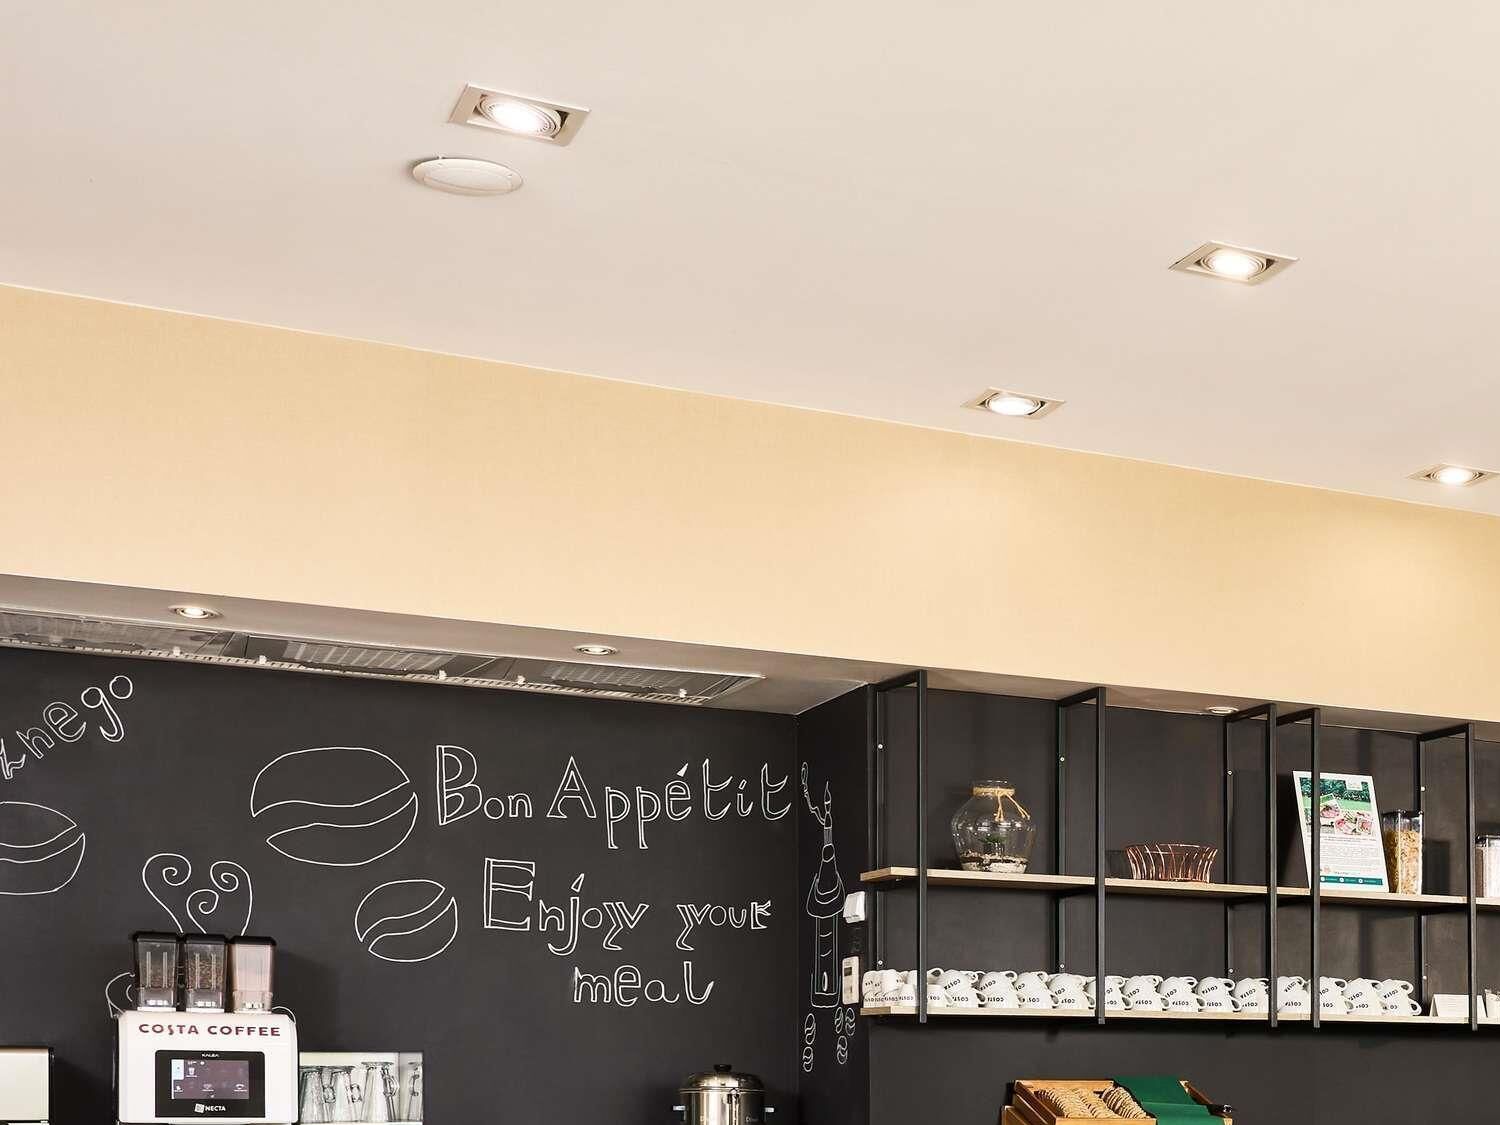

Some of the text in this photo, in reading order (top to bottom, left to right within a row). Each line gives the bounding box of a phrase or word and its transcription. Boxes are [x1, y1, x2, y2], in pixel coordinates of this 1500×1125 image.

[436, 744, 792, 850] Bon Appétit
[483, 857, 772, 956] Enjoy your
[572, 961, 715, 1007] meal
[138, 1023, 281, 1037] COSTA COFFEE
[205, 1104, 227, 1112] NECTA
